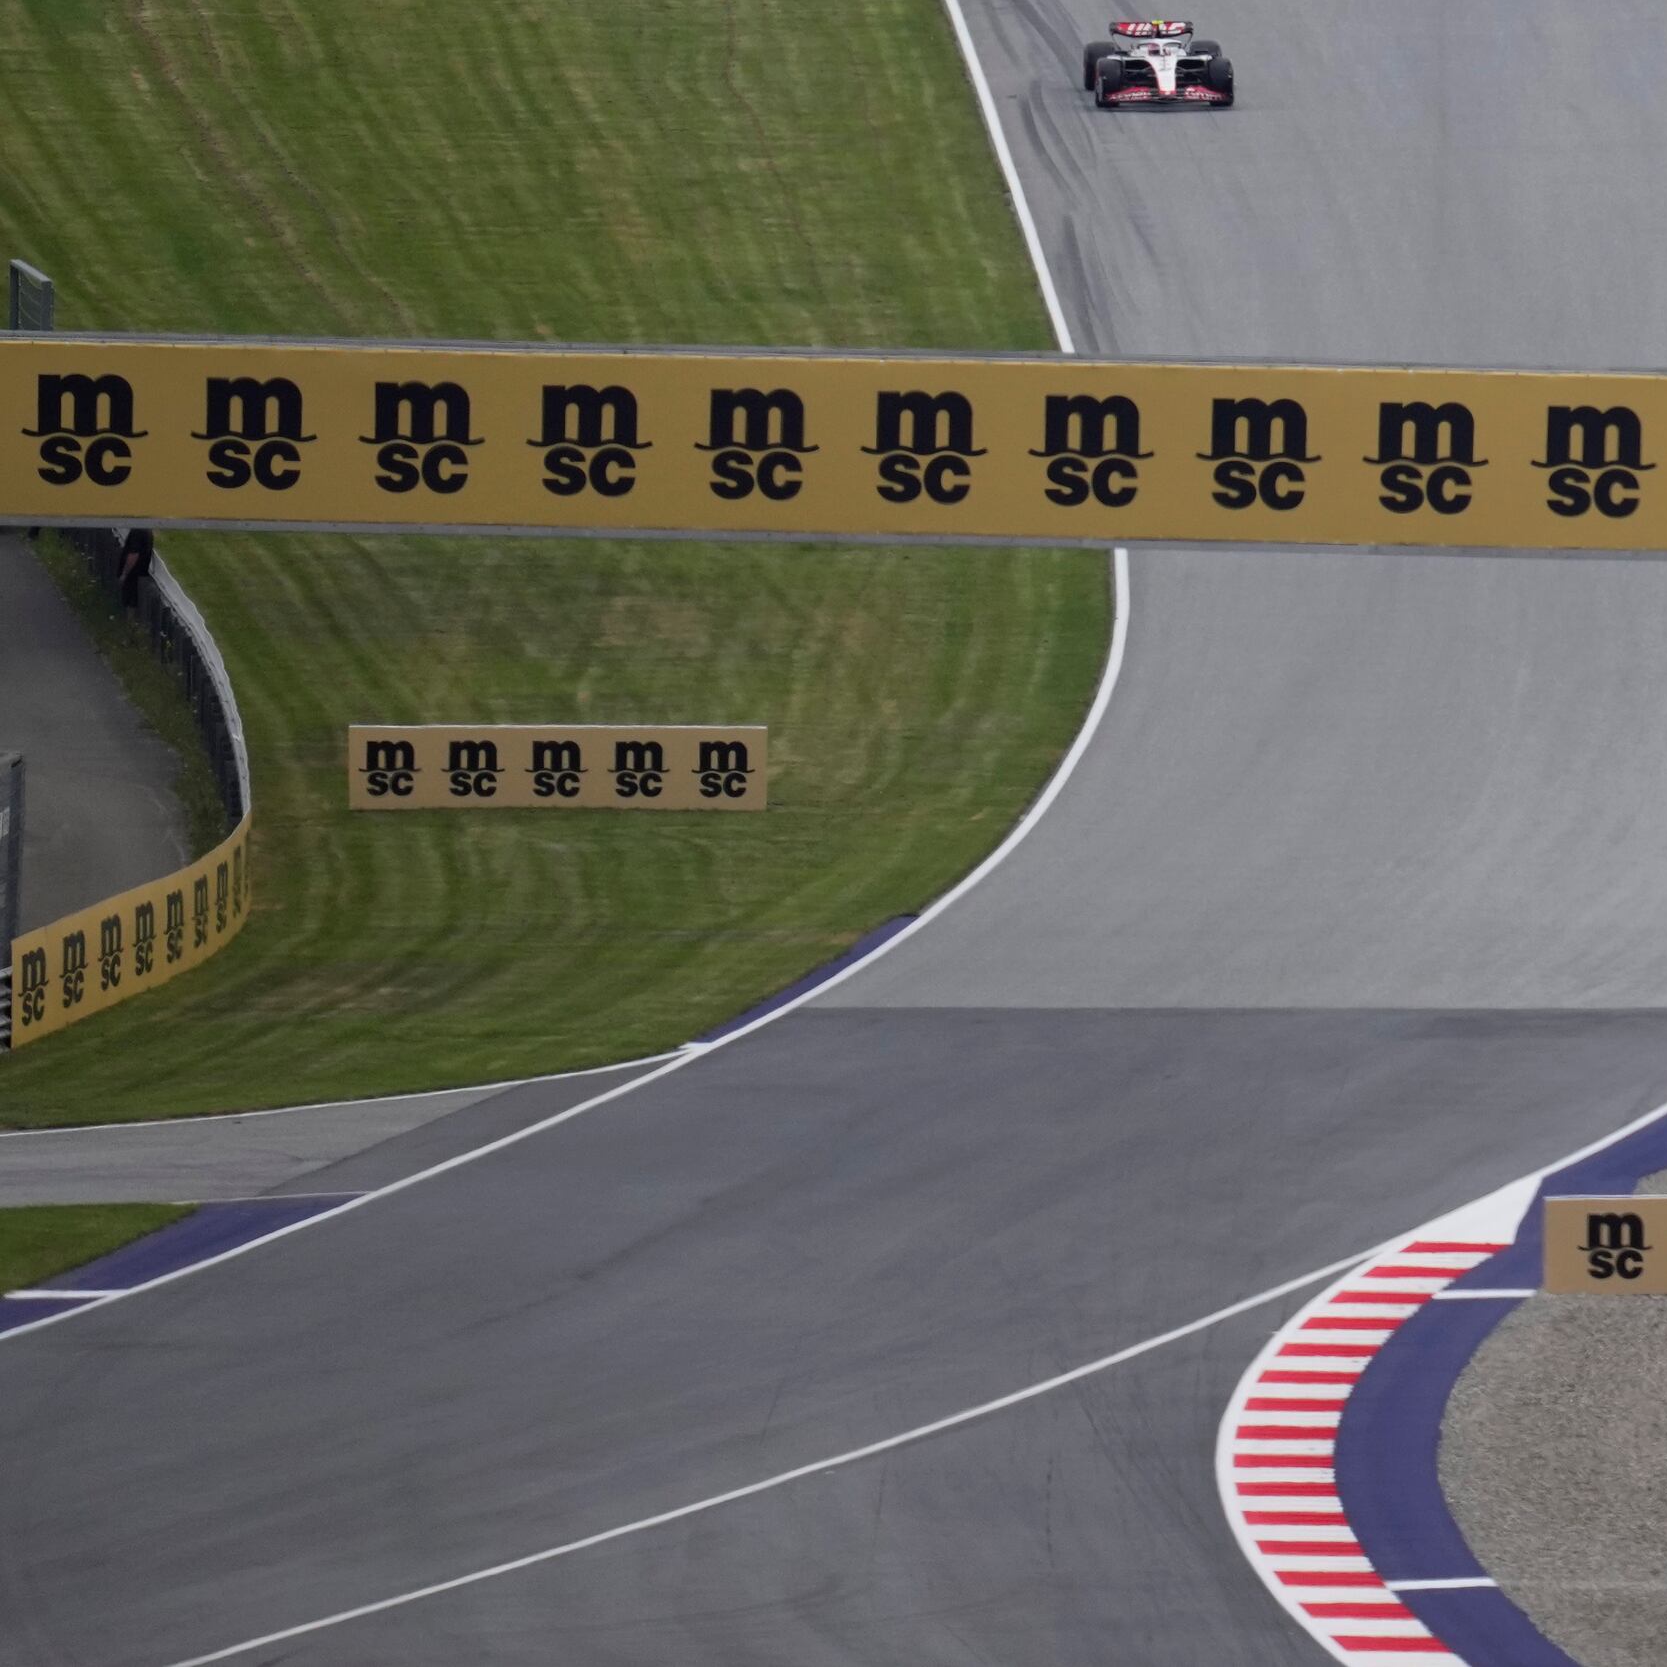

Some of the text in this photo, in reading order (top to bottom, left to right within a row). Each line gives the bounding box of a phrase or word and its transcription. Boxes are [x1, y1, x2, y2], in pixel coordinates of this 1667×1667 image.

[36, 374, 134, 436] m
[205, 377, 303, 440] m
[373, 382, 471, 444] m
[541, 385, 638, 447] m
[708, 388, 805, 451] m
[875, 391, 973, 455] m
[1043, 395, 1140, 458] m
[1211, 398, 1307, 462] m
[1378, 402, 1474, 465] m
[1545, 406, 1642, 469] m
[37, 434, 132, 487] sc
[206, 438, 301, 491] sc
[374, 442, 469, 495] sc
[542, 445, 636, 498] sc
[709, 449, 803, 501] sc
[876, 453, 971, 505] sc
[1044, 456, 1138, 508] sc
[1212, 460, 1305, 511] sc
[1379, 463, 1472, 515] sc
[1546, 467, 1640, 519] sc
[366, 740, 415, 772] m
[449, 740, 499, 772] m
[533, 740, 582, 772] m
[616, 740, 664, 772] m
[700, 740, 749, 772] m
[366, 772, 414, 798] sc
[449, 772, 498, 798] sc
[533, 772, 581, 798] sc
[616, 772, 663, 798] sc
[700, 772, 748, 798] sc
[136, 900, 154, 944] m
[167, 889, 184, 932] m
[63, 930, 85, 975] m
[101, 913, 122, 956] m
[167, 929, 183, 964] sc
[21, 947, 46, 992] m
[101, 953, 121, 991] sc
[136, 942, 153, 976] sc
[22, 988, 45, 1026] sc
[62, 970, 84, 1008] sc
[1588, 1212, 1643, 1249] m
[1588, 1249, 1643, 1279] sc
